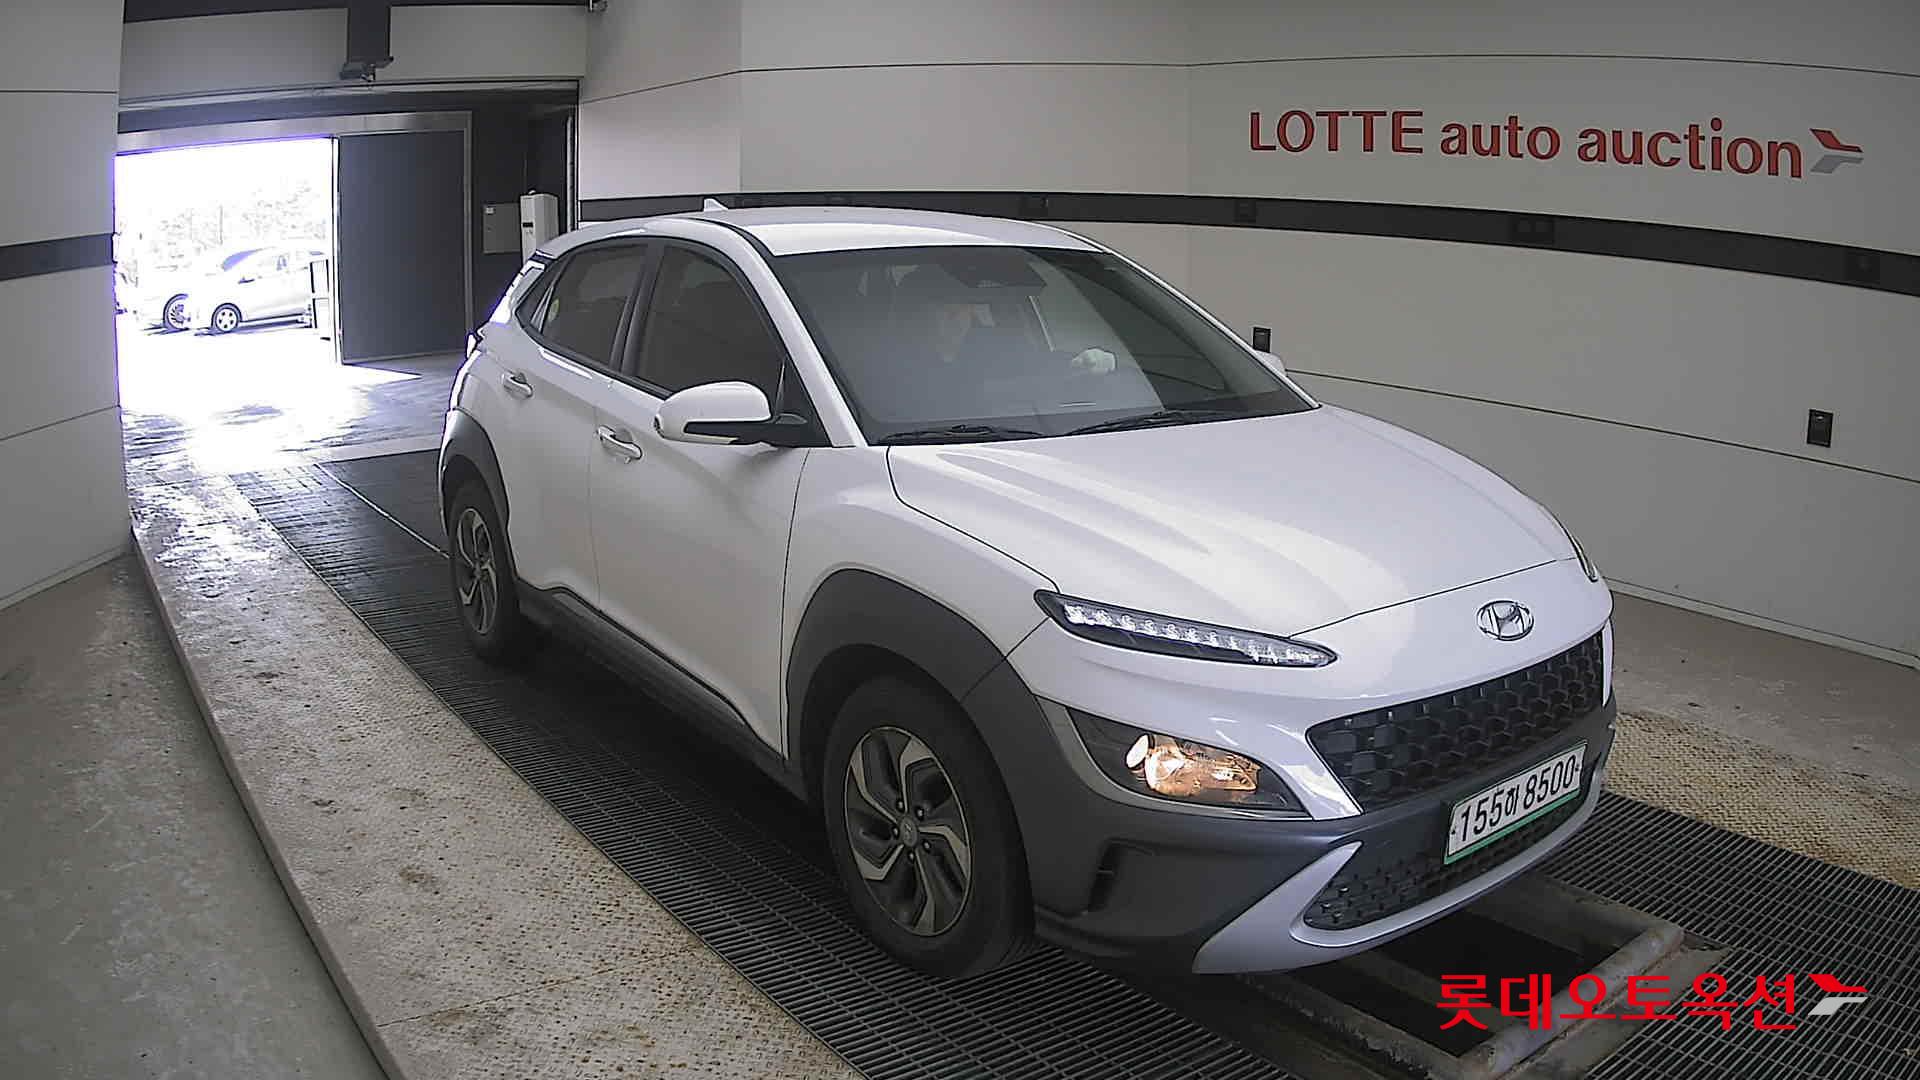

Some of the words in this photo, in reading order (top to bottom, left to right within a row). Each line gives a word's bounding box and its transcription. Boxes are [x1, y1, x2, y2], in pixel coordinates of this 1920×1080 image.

[1250, 111, 1424, 154] LOTTE
[1440, 115, 1561, 161] auto
[1577, 117, 1803, 179] auction
[1523, 754, 1577, 810] 8500
